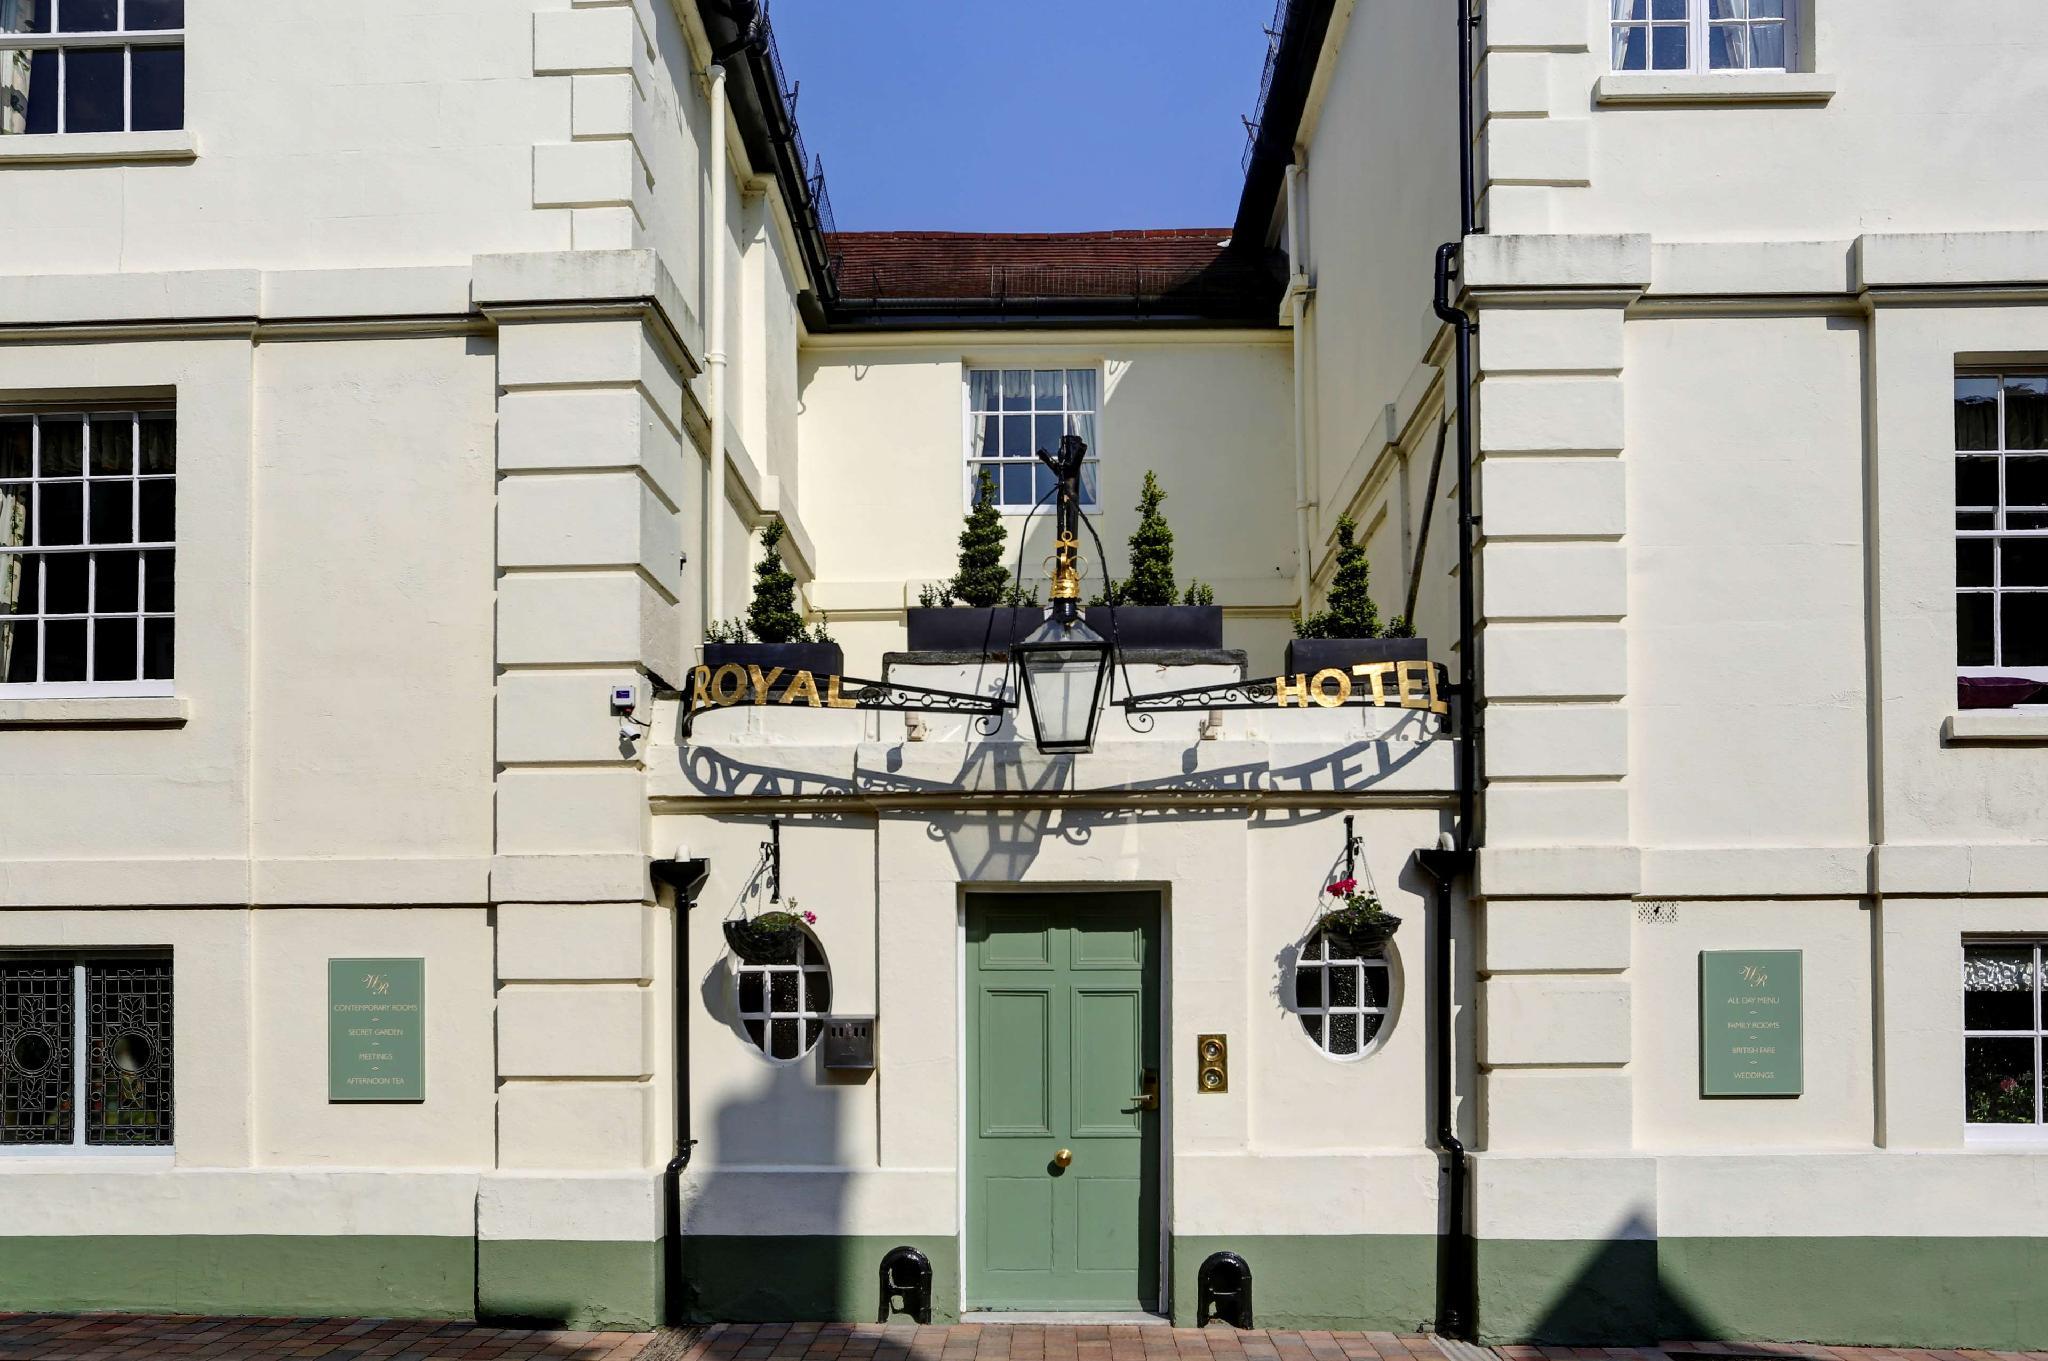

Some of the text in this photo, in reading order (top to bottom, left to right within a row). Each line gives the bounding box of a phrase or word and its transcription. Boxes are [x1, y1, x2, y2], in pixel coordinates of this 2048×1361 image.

[691, 660, 1447, 714] ROYAL HOTEL
[1727, 996, 1780, 1005] ALL DAY MENU
[334, 1004, 418, 1013] CONTEMPORARY ROOMS
[1727, 1021, 1780, 1030] FAMILY ROOMS
[348, 1028, 404, 1037] SECRET GARDEN
[1732, 1046, 1777, 1054] BRITISH FARE
[359, 1053, 393, 1061] MEETINGS
[1734, 1071, 1775, 1079] WEDDINGS
[347, 1077, 405, 1085] AFTERNOON TEA
